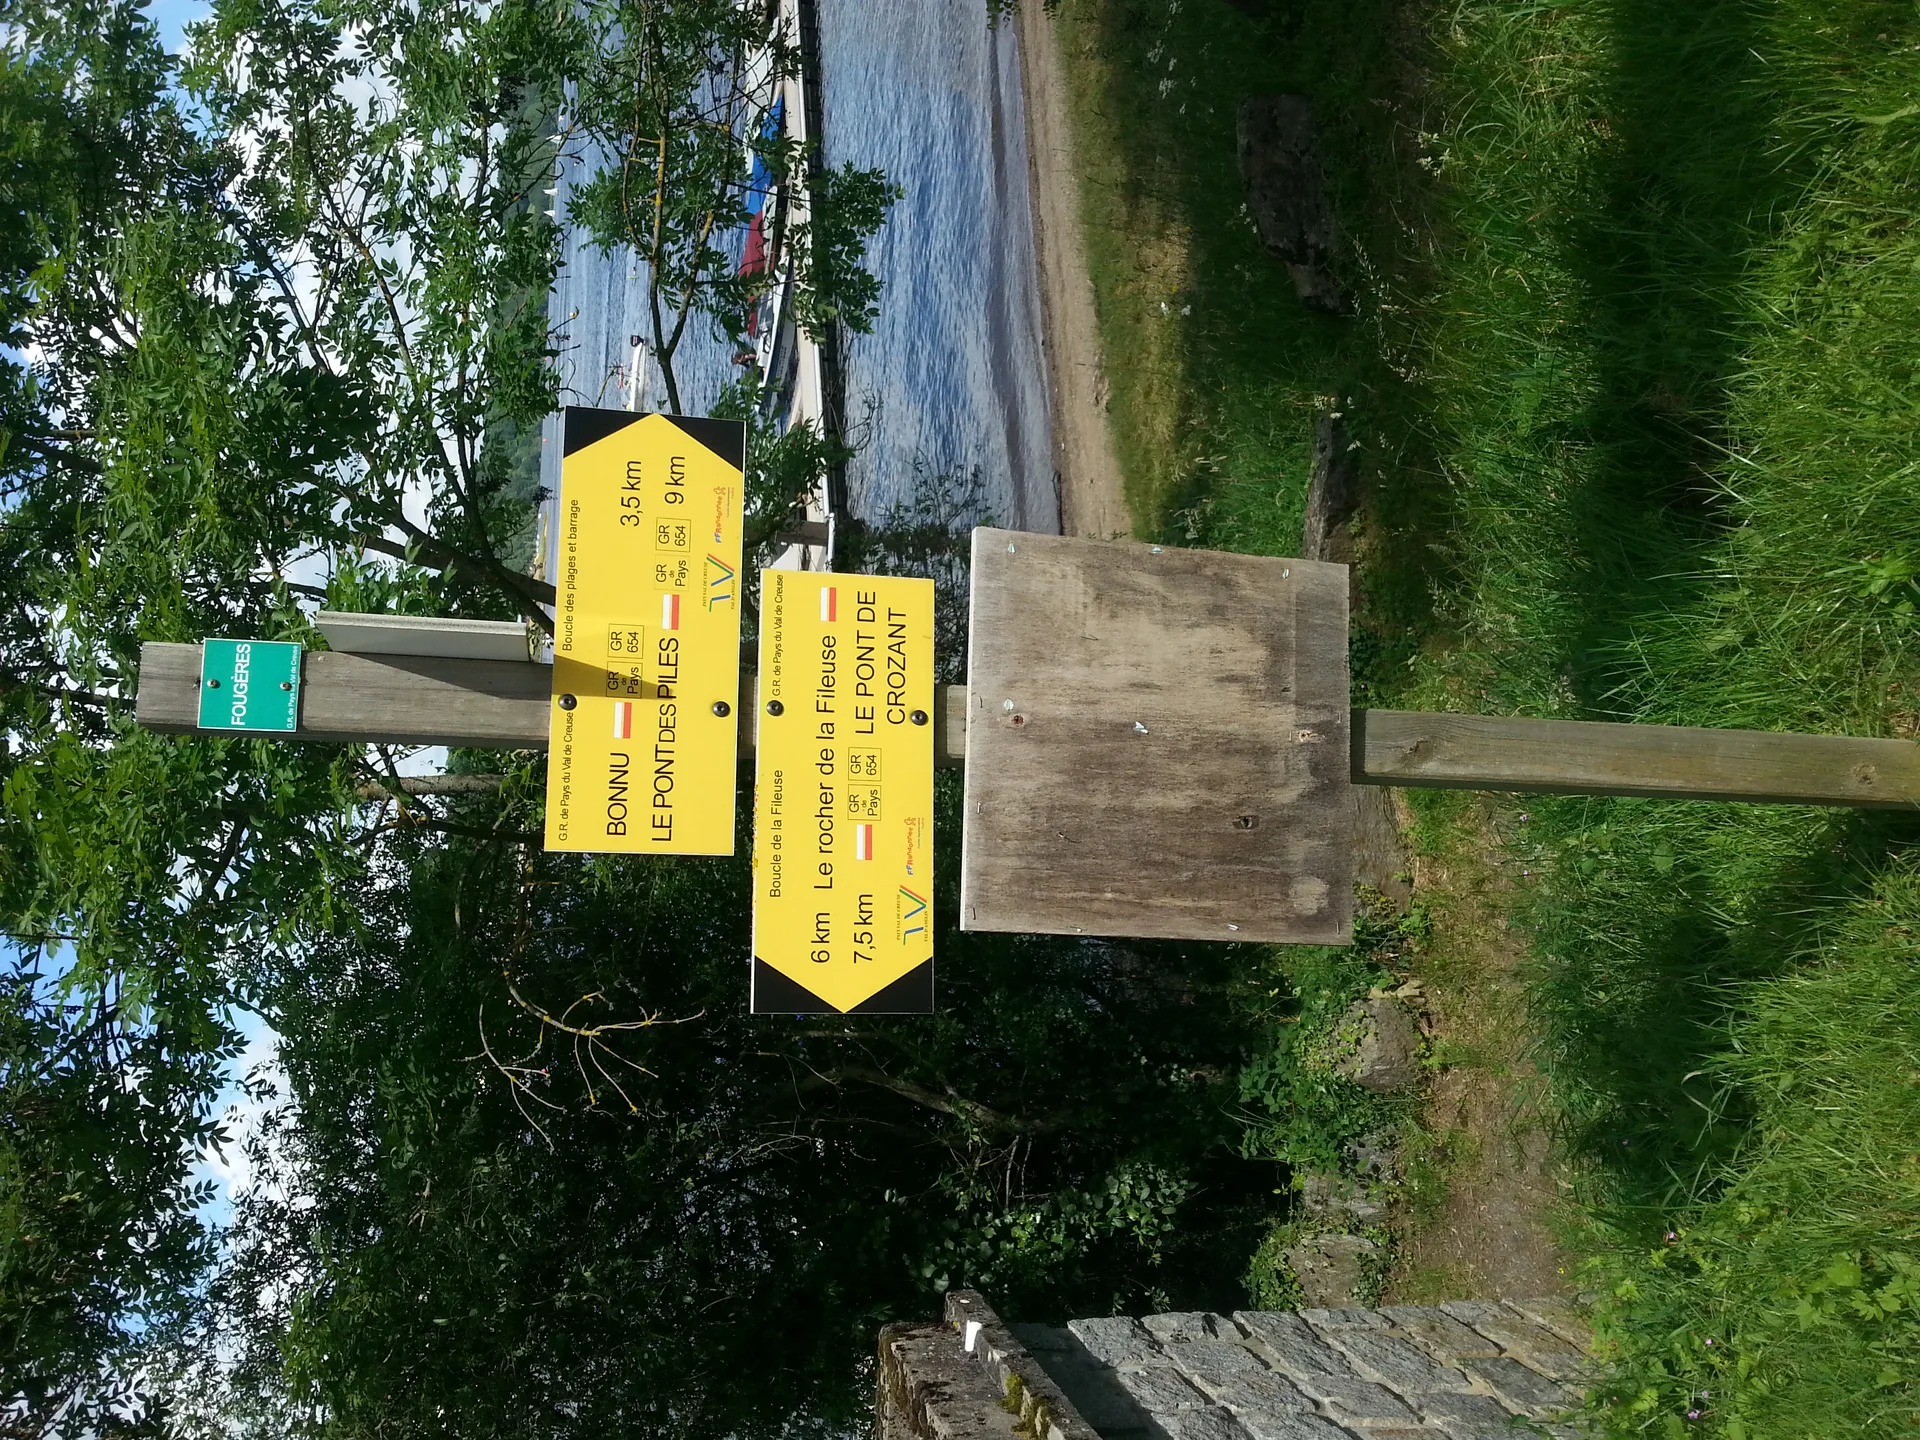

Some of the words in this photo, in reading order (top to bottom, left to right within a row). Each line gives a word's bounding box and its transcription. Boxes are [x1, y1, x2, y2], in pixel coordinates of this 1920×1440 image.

[621, 460, 641, 491] km
[665, 456, 685, 486] km
[664, 491, 684, 505] 9
[568, 499, 580, 539] barrage
[620, 496, 643, 527] 3,5
[658, 525, 669, 544] GR
[674, 525, 686, 547] 654
[568, 542, 576, 553] et
[566, 556, 577, 590] plages
[656, 564, 667, 583] GR
[676, 560, 688, 587] Pays
[775, 574, 784, 603] Creuse
[564, 593, 574, 612] des
[774, 604, 783, 615] de
[858, 591, 876, 622] DE
[562, 616, 573, 651] Boucle
[774, 617, 782, 629] Val
[611, 631, 622, 651] GR
[627, 631, 639, 653] 654
[774, 631, 782, 642] du
[773, 643, 783, 663] Pays
[856, 630, 875, 697] PONT
[657, 637, 679, 699] PILES
[773, 665, 781, 675] de
[816, 636, 836, 713] Fileuse
[887, 607, 907, 725] CROZANT
[231, 644, 251, 726] FOUGÈRES
[608, 671, 619, 690] GR
[621, 677, 627, 685] de
[627, 667, 641, 694] Pays
[772, 677, 781, 696] G.R.
[564, 712, 573, 743] Creuse
[658, 703, 676, 743] DES
[816, 722, 834, 740] la
[855, 706, 874, 735] LE
[563, 744, 572, 755] de
[815, 748, 834, 775] de
[562, 757, 571, 770] Val
[850, 754, 861, 774] GR
[866, 754, 877, 776] 654
[562, 772, 570, 783] du
[652, 744, 675, 808] PONT
[561, 785, 571, 806] Pays
[606, 752, 630, 836] BONNU
[770, 770, 783, 815] Fileuse
[849, 794, 859, 813] GR
[861, 800, 867, 808] de
[868, 789, 880, 816] Pays
[560, 808, 568, 819] de
[771, 820, 782, 830] la
[814, 783, 834, 853] rocher
[559, 821, 568, 841] G.R.
[651, 814, 672, 842] LE
[771, 834, 781, 850] de
[769, 854, 781, 898] Boucle
[814, 862, 833, 890] Le
[854, 894, 873, 925] km
[811, 912, 830, 944] km
[810, 949, 830, 963] 6
[853, 931, 876, 964] 7,5
